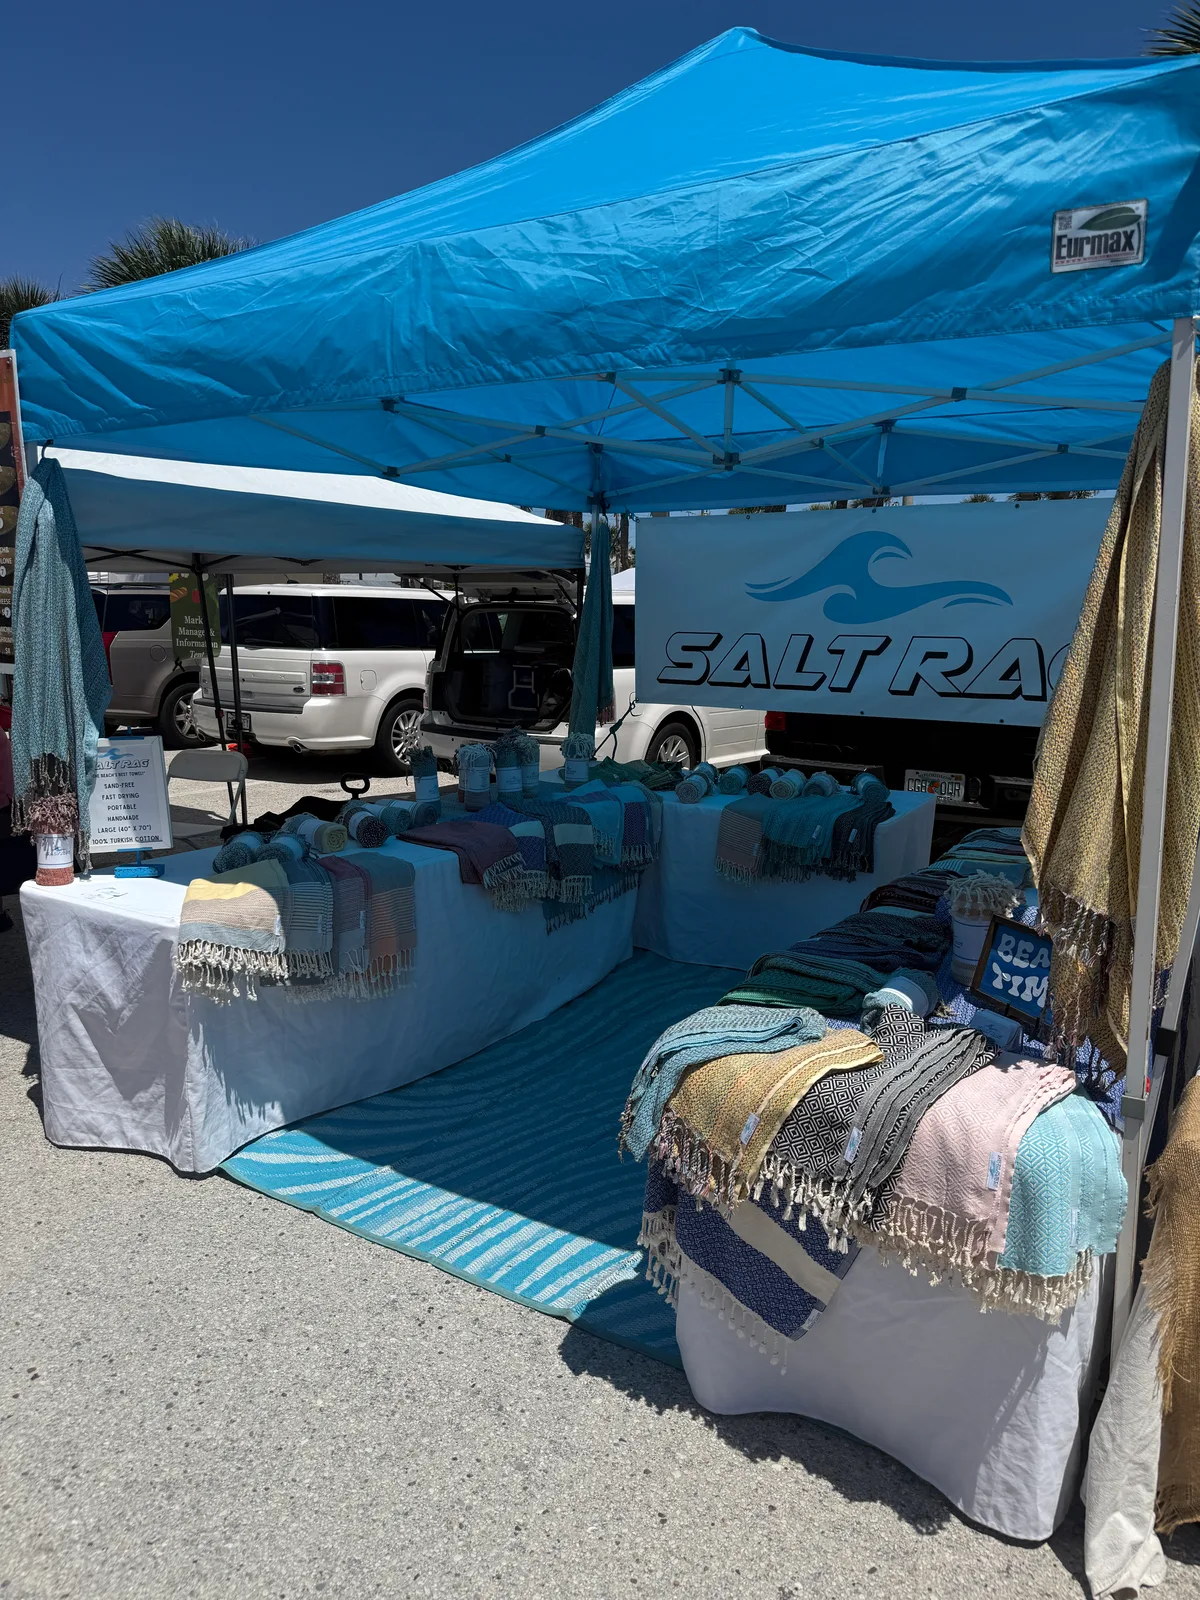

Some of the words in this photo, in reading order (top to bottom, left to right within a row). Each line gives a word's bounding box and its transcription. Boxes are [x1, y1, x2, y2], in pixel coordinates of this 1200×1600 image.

[1055, 229, 1136, 260] Eurmax
[178, 626, 206, 638] Manage
[209, 627, 216, 637] &
[184, 615, 204, 625] Mark
[657, 631, 892, 694] SALT
[95, 761, 120, 770] ALT
[121, 759, 150, 769] RAG
[997, 933, 1051, 969] BEA
[992, 962, 1050, 1008] TIM
